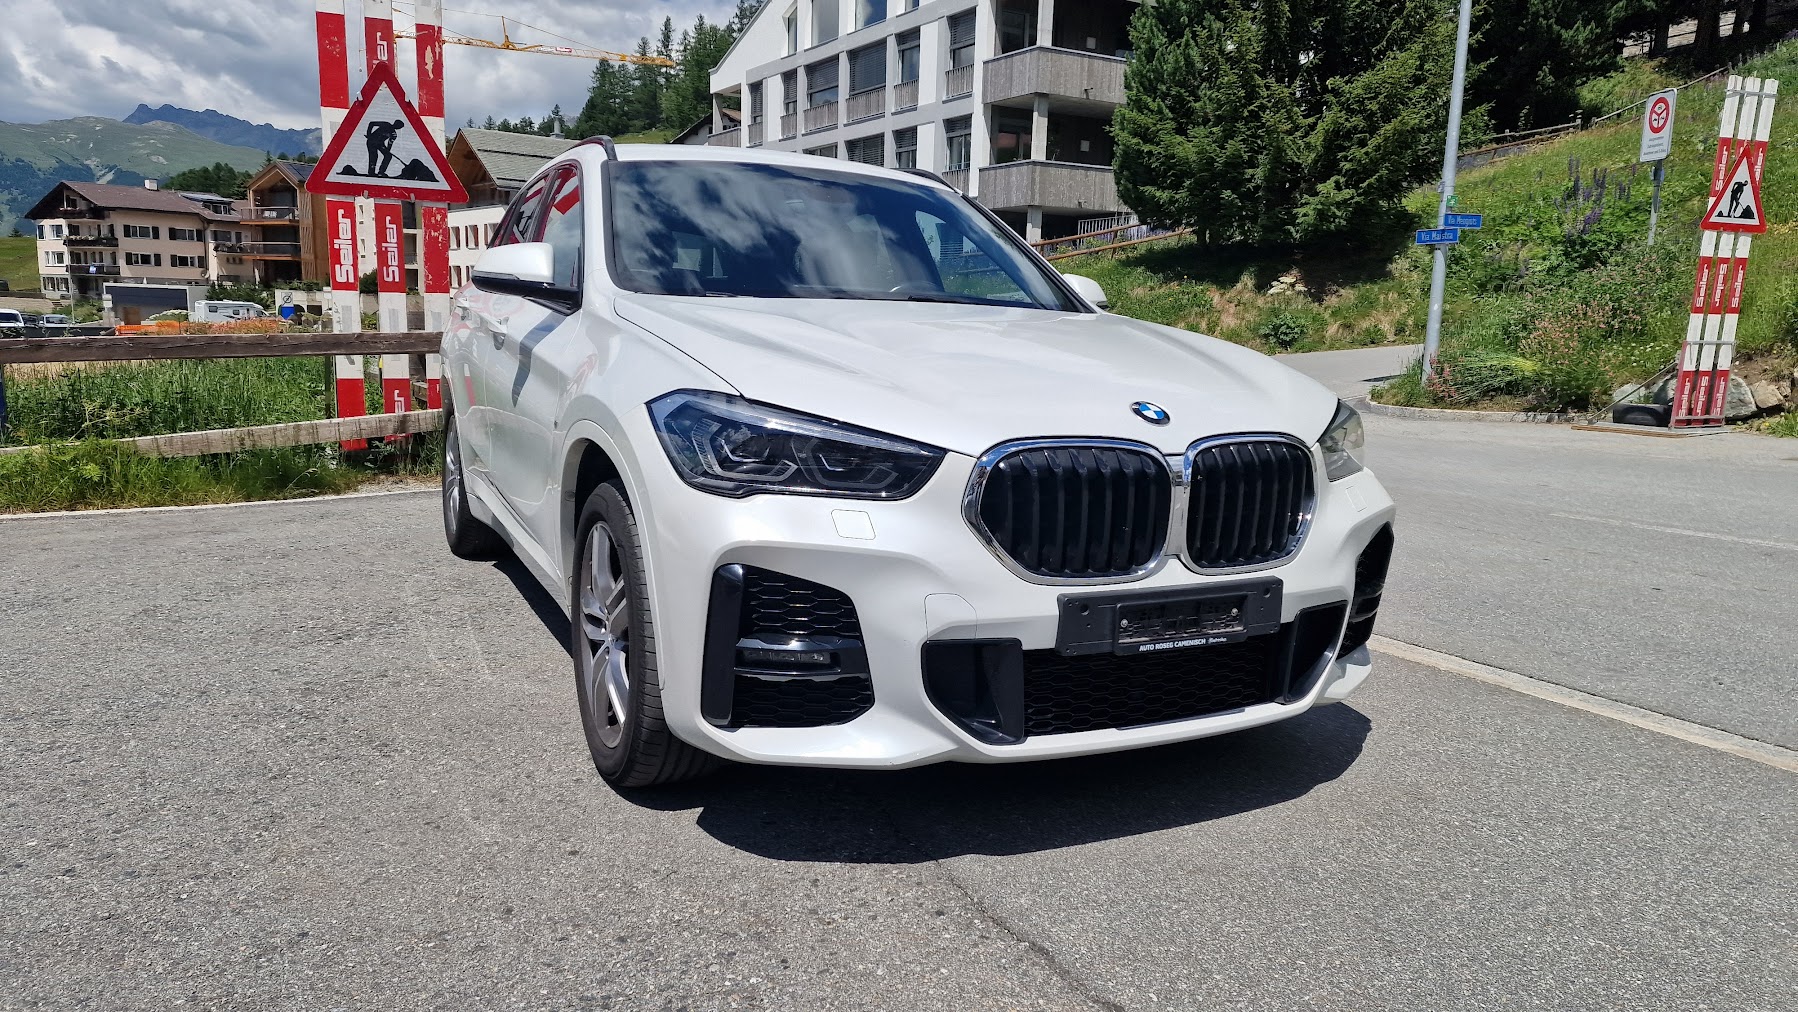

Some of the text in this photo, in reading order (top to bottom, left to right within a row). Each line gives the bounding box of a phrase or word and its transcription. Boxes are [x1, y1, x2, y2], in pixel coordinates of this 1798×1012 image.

[1754, 147, 1764, 184] eiler
[333, 208, 355, 283] Seiler
[381, 215, 400, 283] Seiler
[1421, 230, 1454, 241] Via Maistra
[1139, 644, 1155, 652] AUTO
[1155, 642, 1174, 650] ROSEG
[1174, 638, 1206, 648] CAMENISCH
